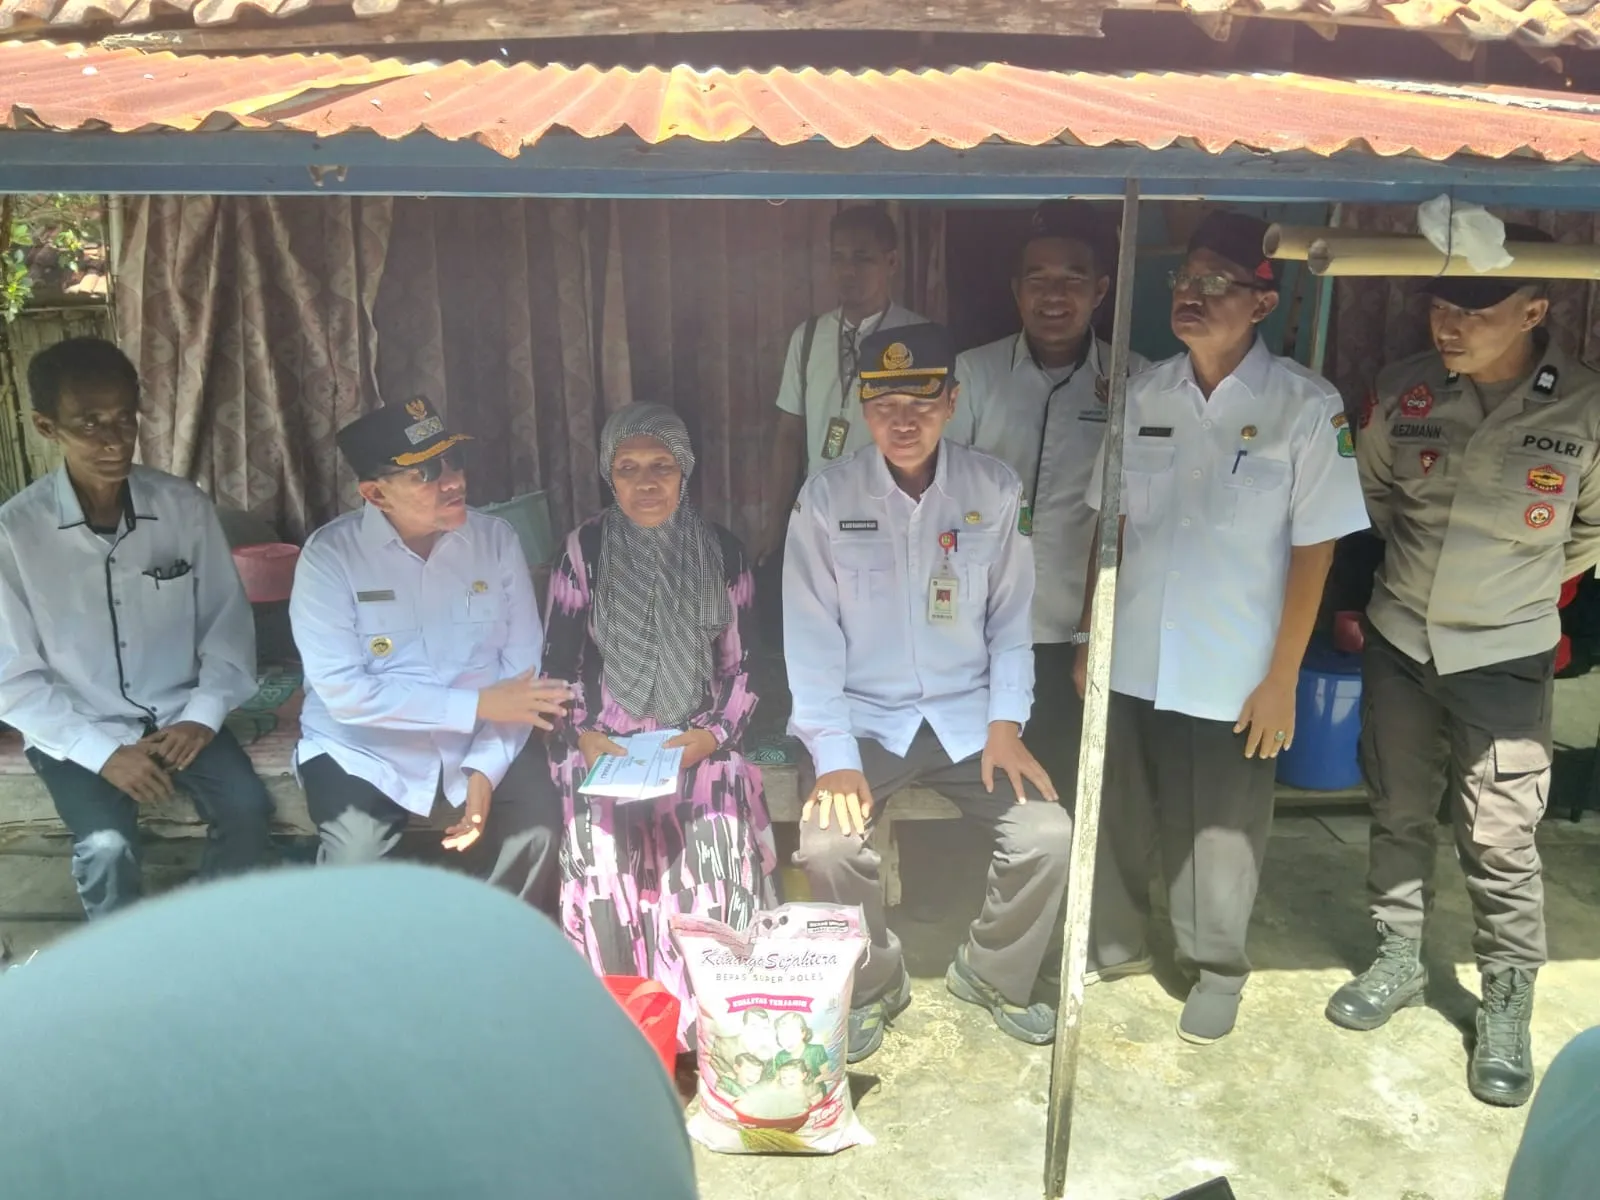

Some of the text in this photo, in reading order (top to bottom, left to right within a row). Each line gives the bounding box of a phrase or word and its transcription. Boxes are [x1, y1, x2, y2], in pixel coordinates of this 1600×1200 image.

[1522, 434, 1584, 458] POLRI
[764, 950, 838, 972] Sejahtera
[715, 972, 824, 984] BERAS SUPER POLES
